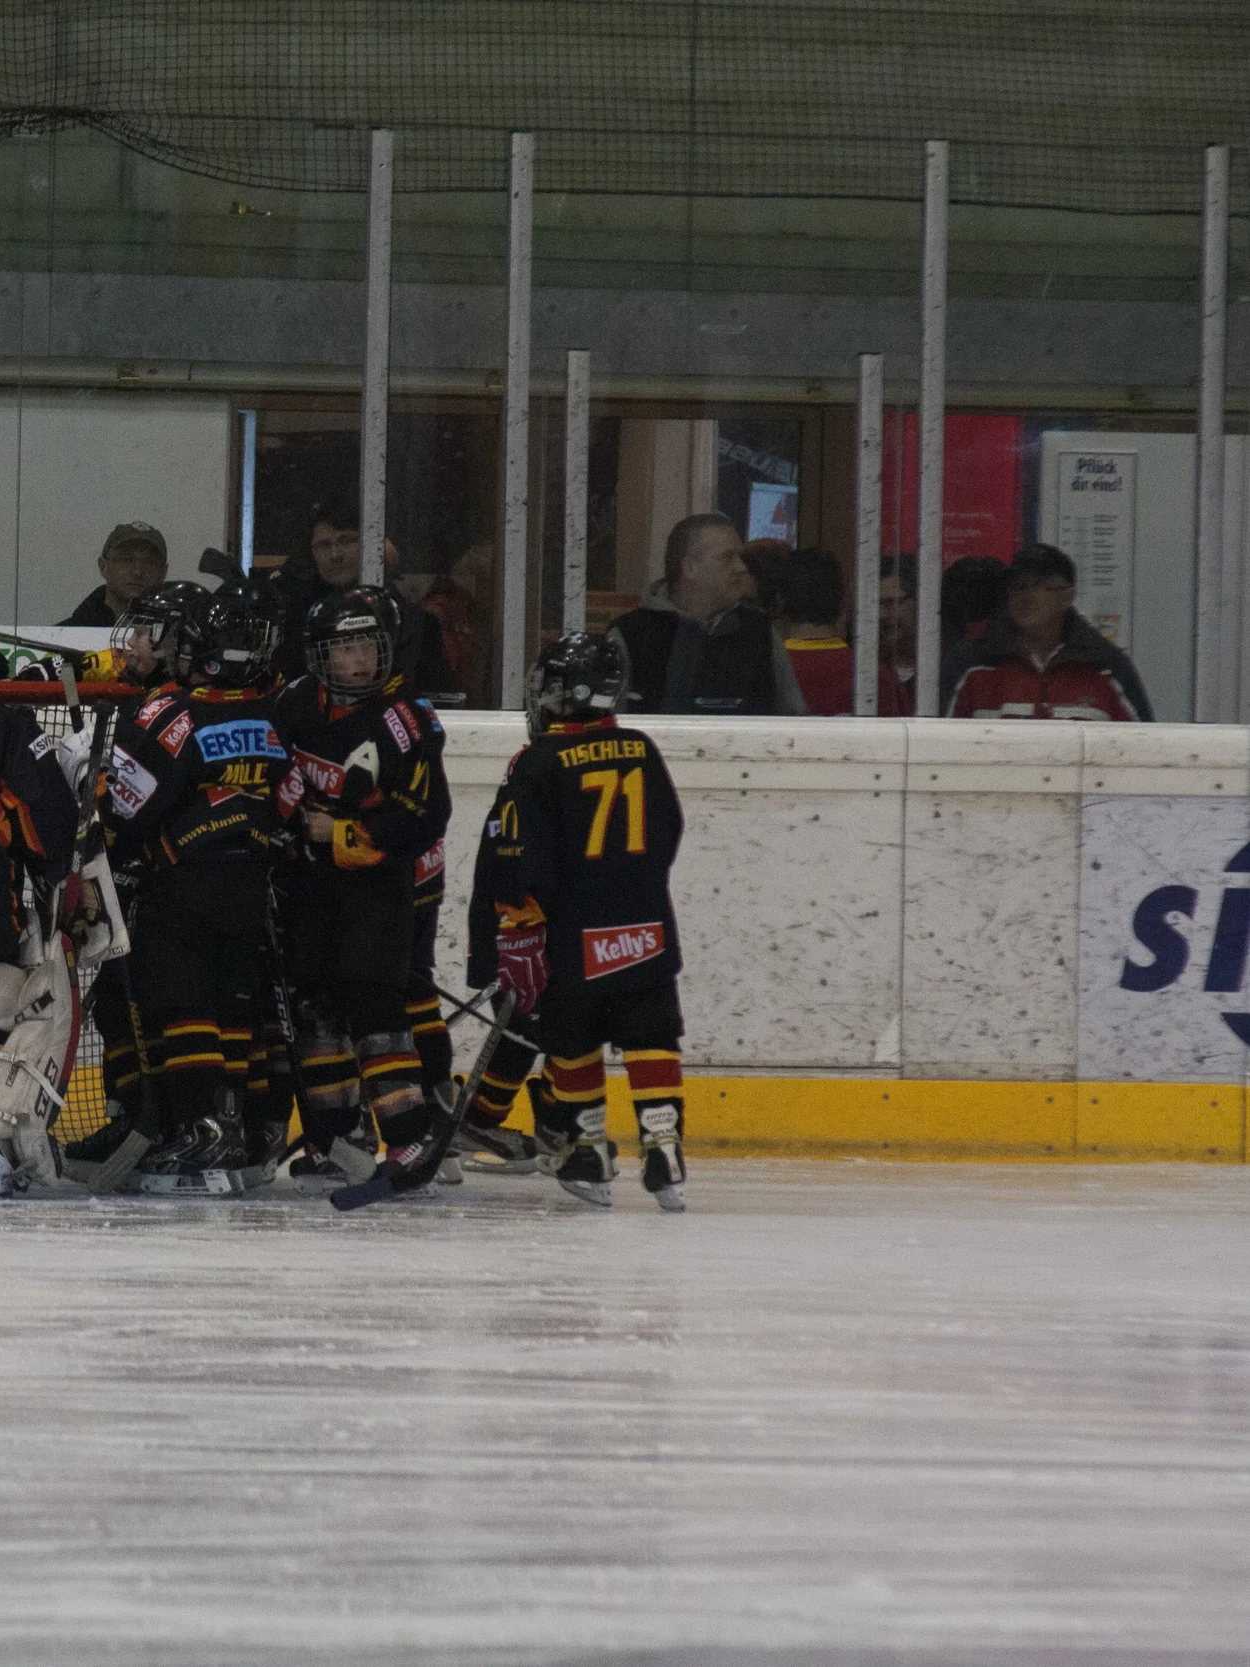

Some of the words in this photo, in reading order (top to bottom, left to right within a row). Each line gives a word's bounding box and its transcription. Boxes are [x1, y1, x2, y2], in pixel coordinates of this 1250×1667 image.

[1076, 457, 1117, 474] Pflück
[1092, 474, 1123, 492] eins!
[200, 728, 266, 758] ERSTE
[384, 708, 411, 752] RICOH
[557, 740, 647, 768] TISCHLER
[581, 767, 647, 861] 71
[593, 929, 658, 964] Kelly's
